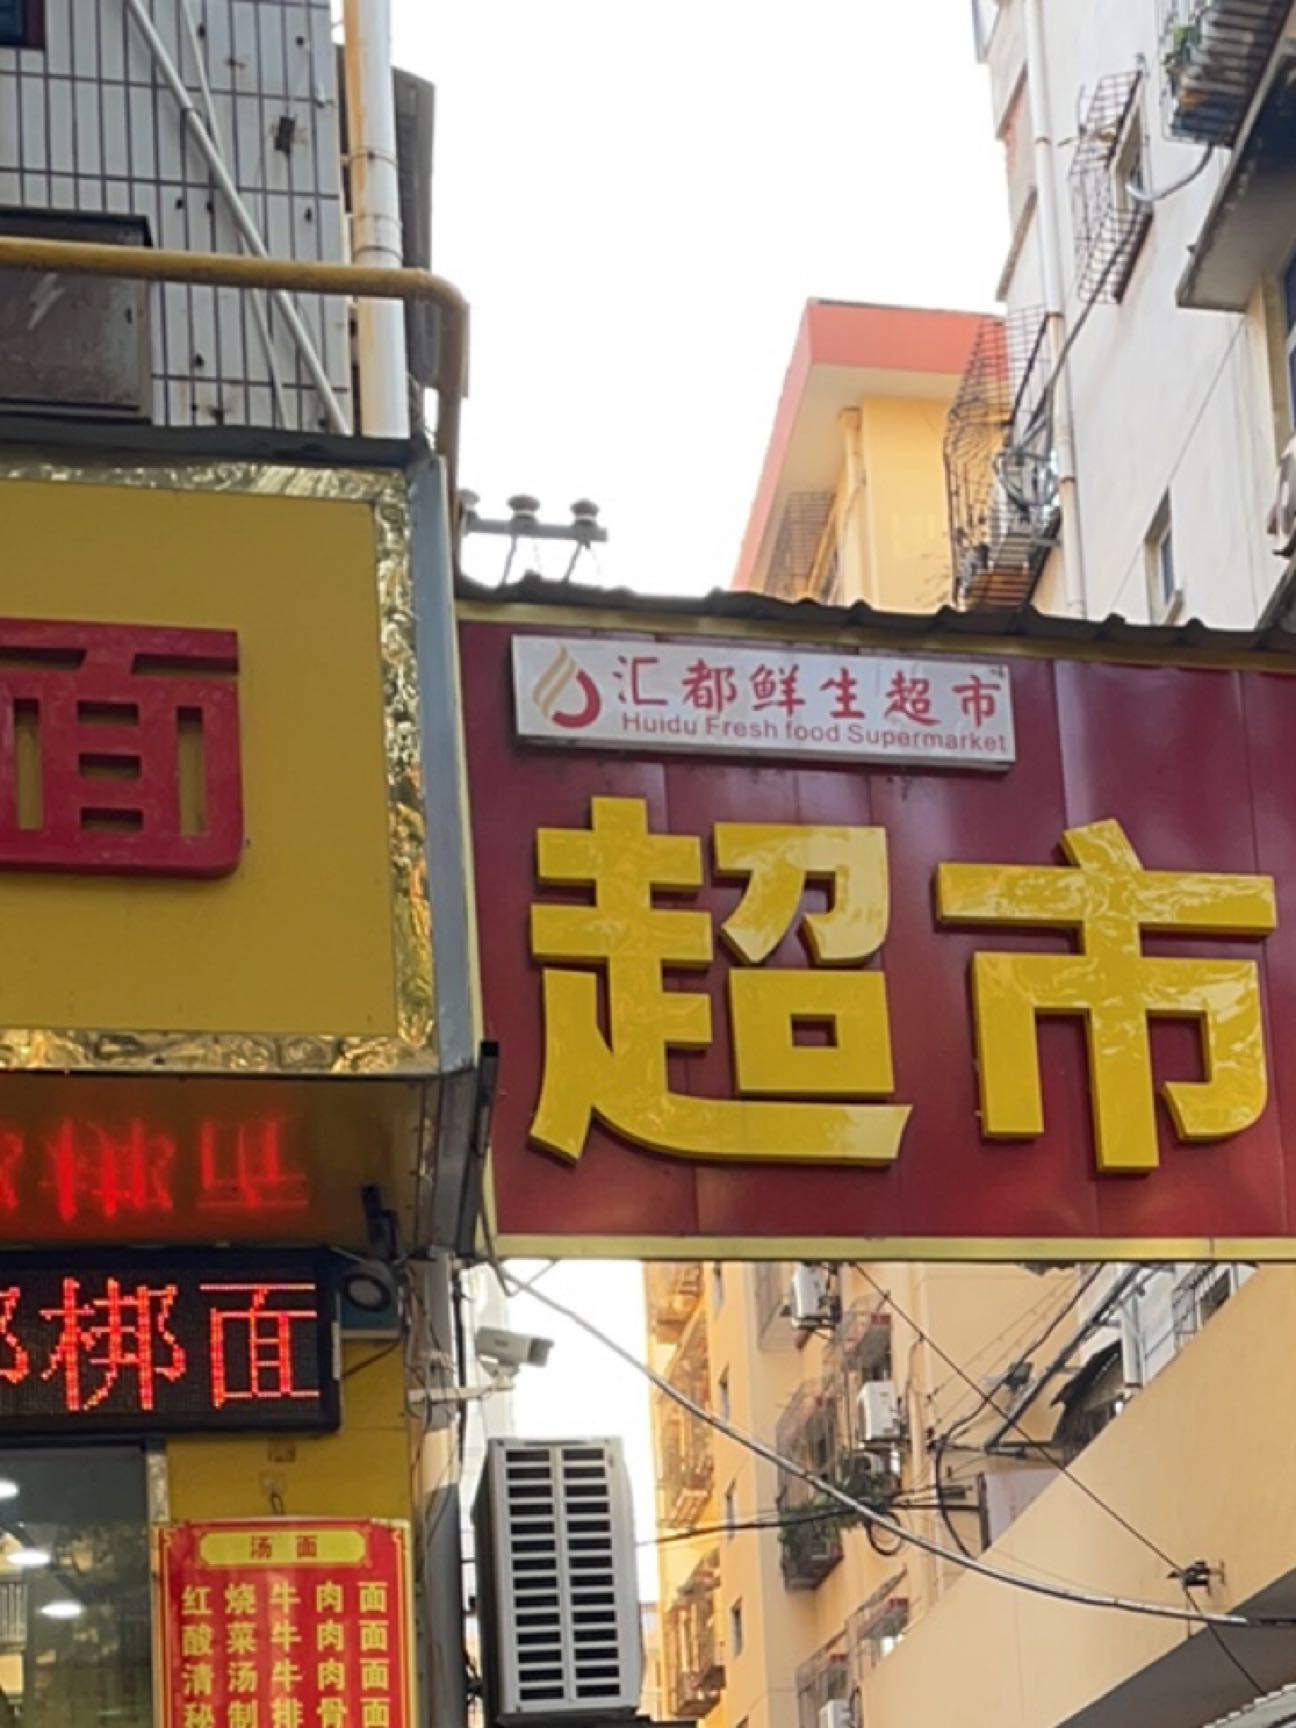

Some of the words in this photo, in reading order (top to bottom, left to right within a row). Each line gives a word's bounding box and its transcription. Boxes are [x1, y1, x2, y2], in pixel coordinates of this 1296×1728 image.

[612, 655, 1002, 728] 汇都鲜生超市
[0, 617, 244, 878] 面
[621, 711, 698, 737] Huidu
[705, 712, 778, 740] Fresh
[785, 718, 841, 744] food
[847, 724, 1008, 753] Supermarket
[250, 1534, 318, 1560] 汤面
[181, 1579, 388, 1616] 红烧牛肉面
[181, 1617, 389, 1657] 酸菜牛肉面
[181, 1656, 390, 1695] 清汤牛肉面
